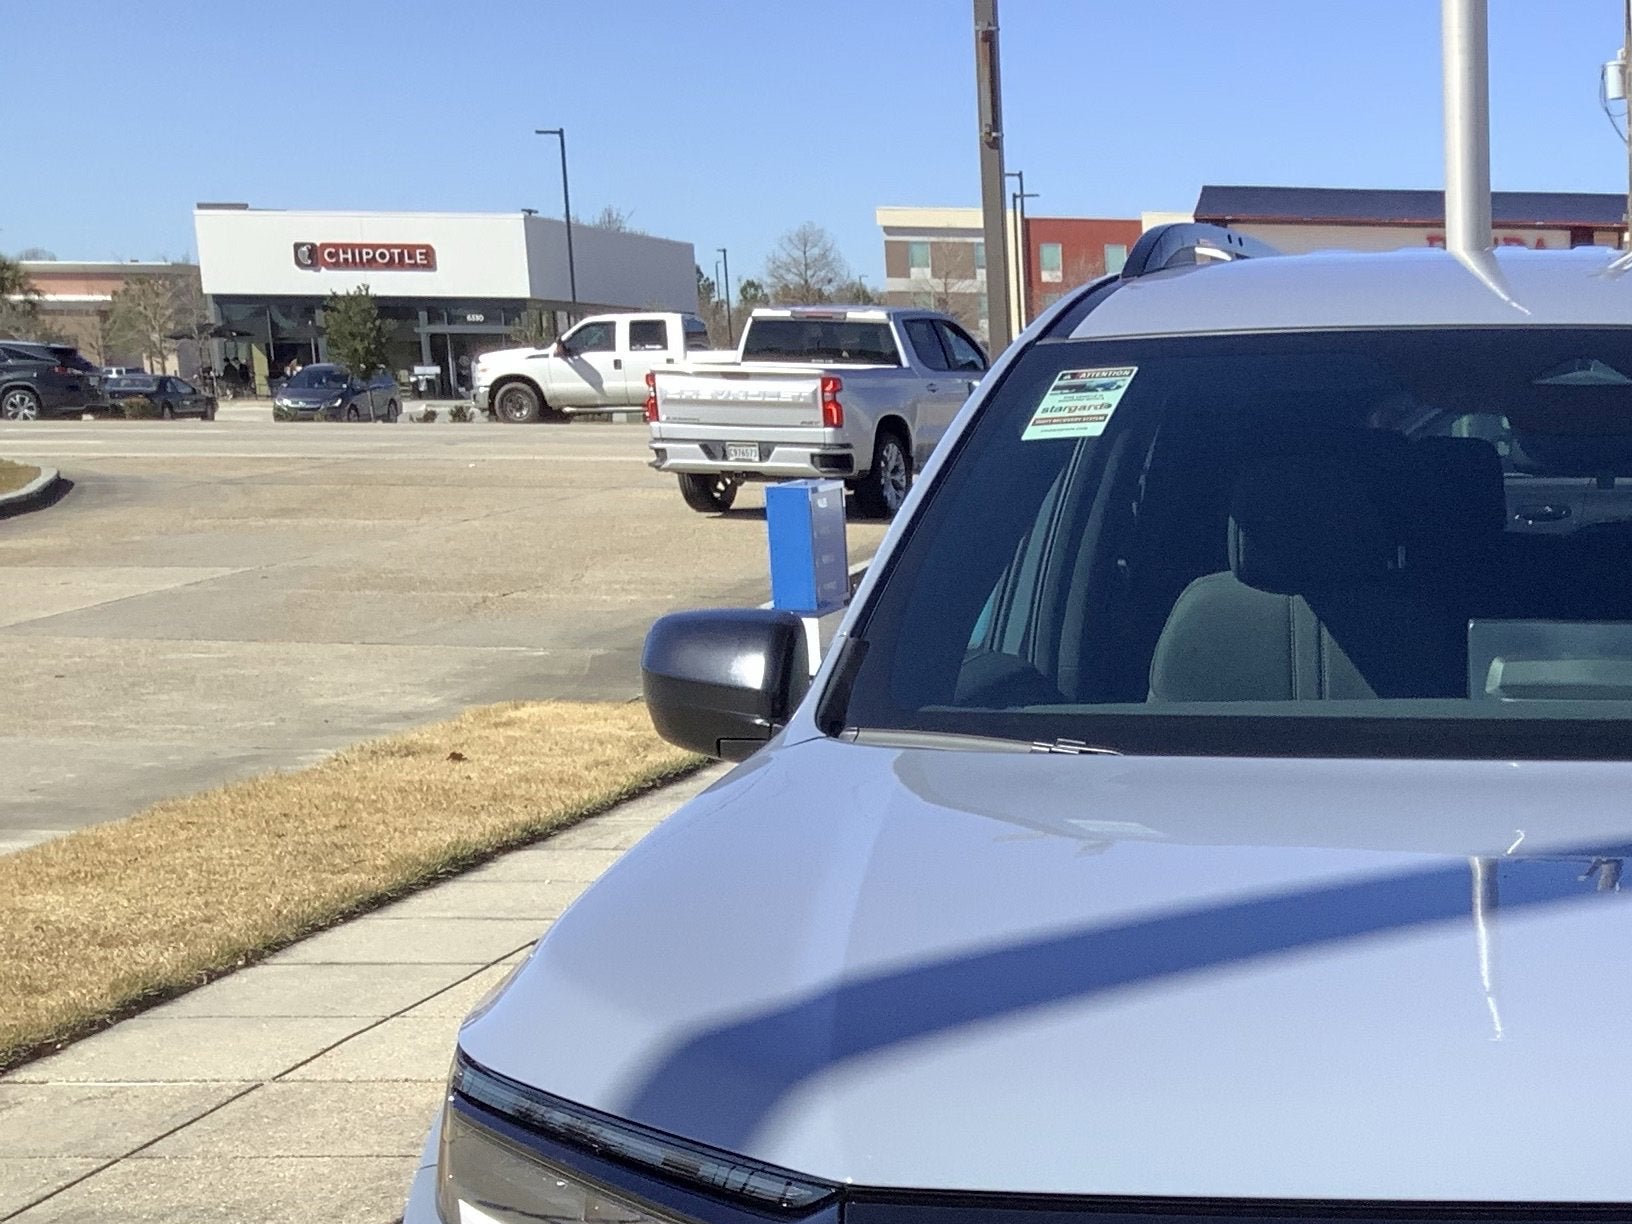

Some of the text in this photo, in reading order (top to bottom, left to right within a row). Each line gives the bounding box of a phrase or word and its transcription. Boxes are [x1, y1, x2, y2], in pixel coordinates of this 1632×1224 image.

[323, 247, 428, 264] CHIPOTLE
[1079, 370, 1131, 379] ATTENTION
[1041, 403, 1104, 414] stargard
